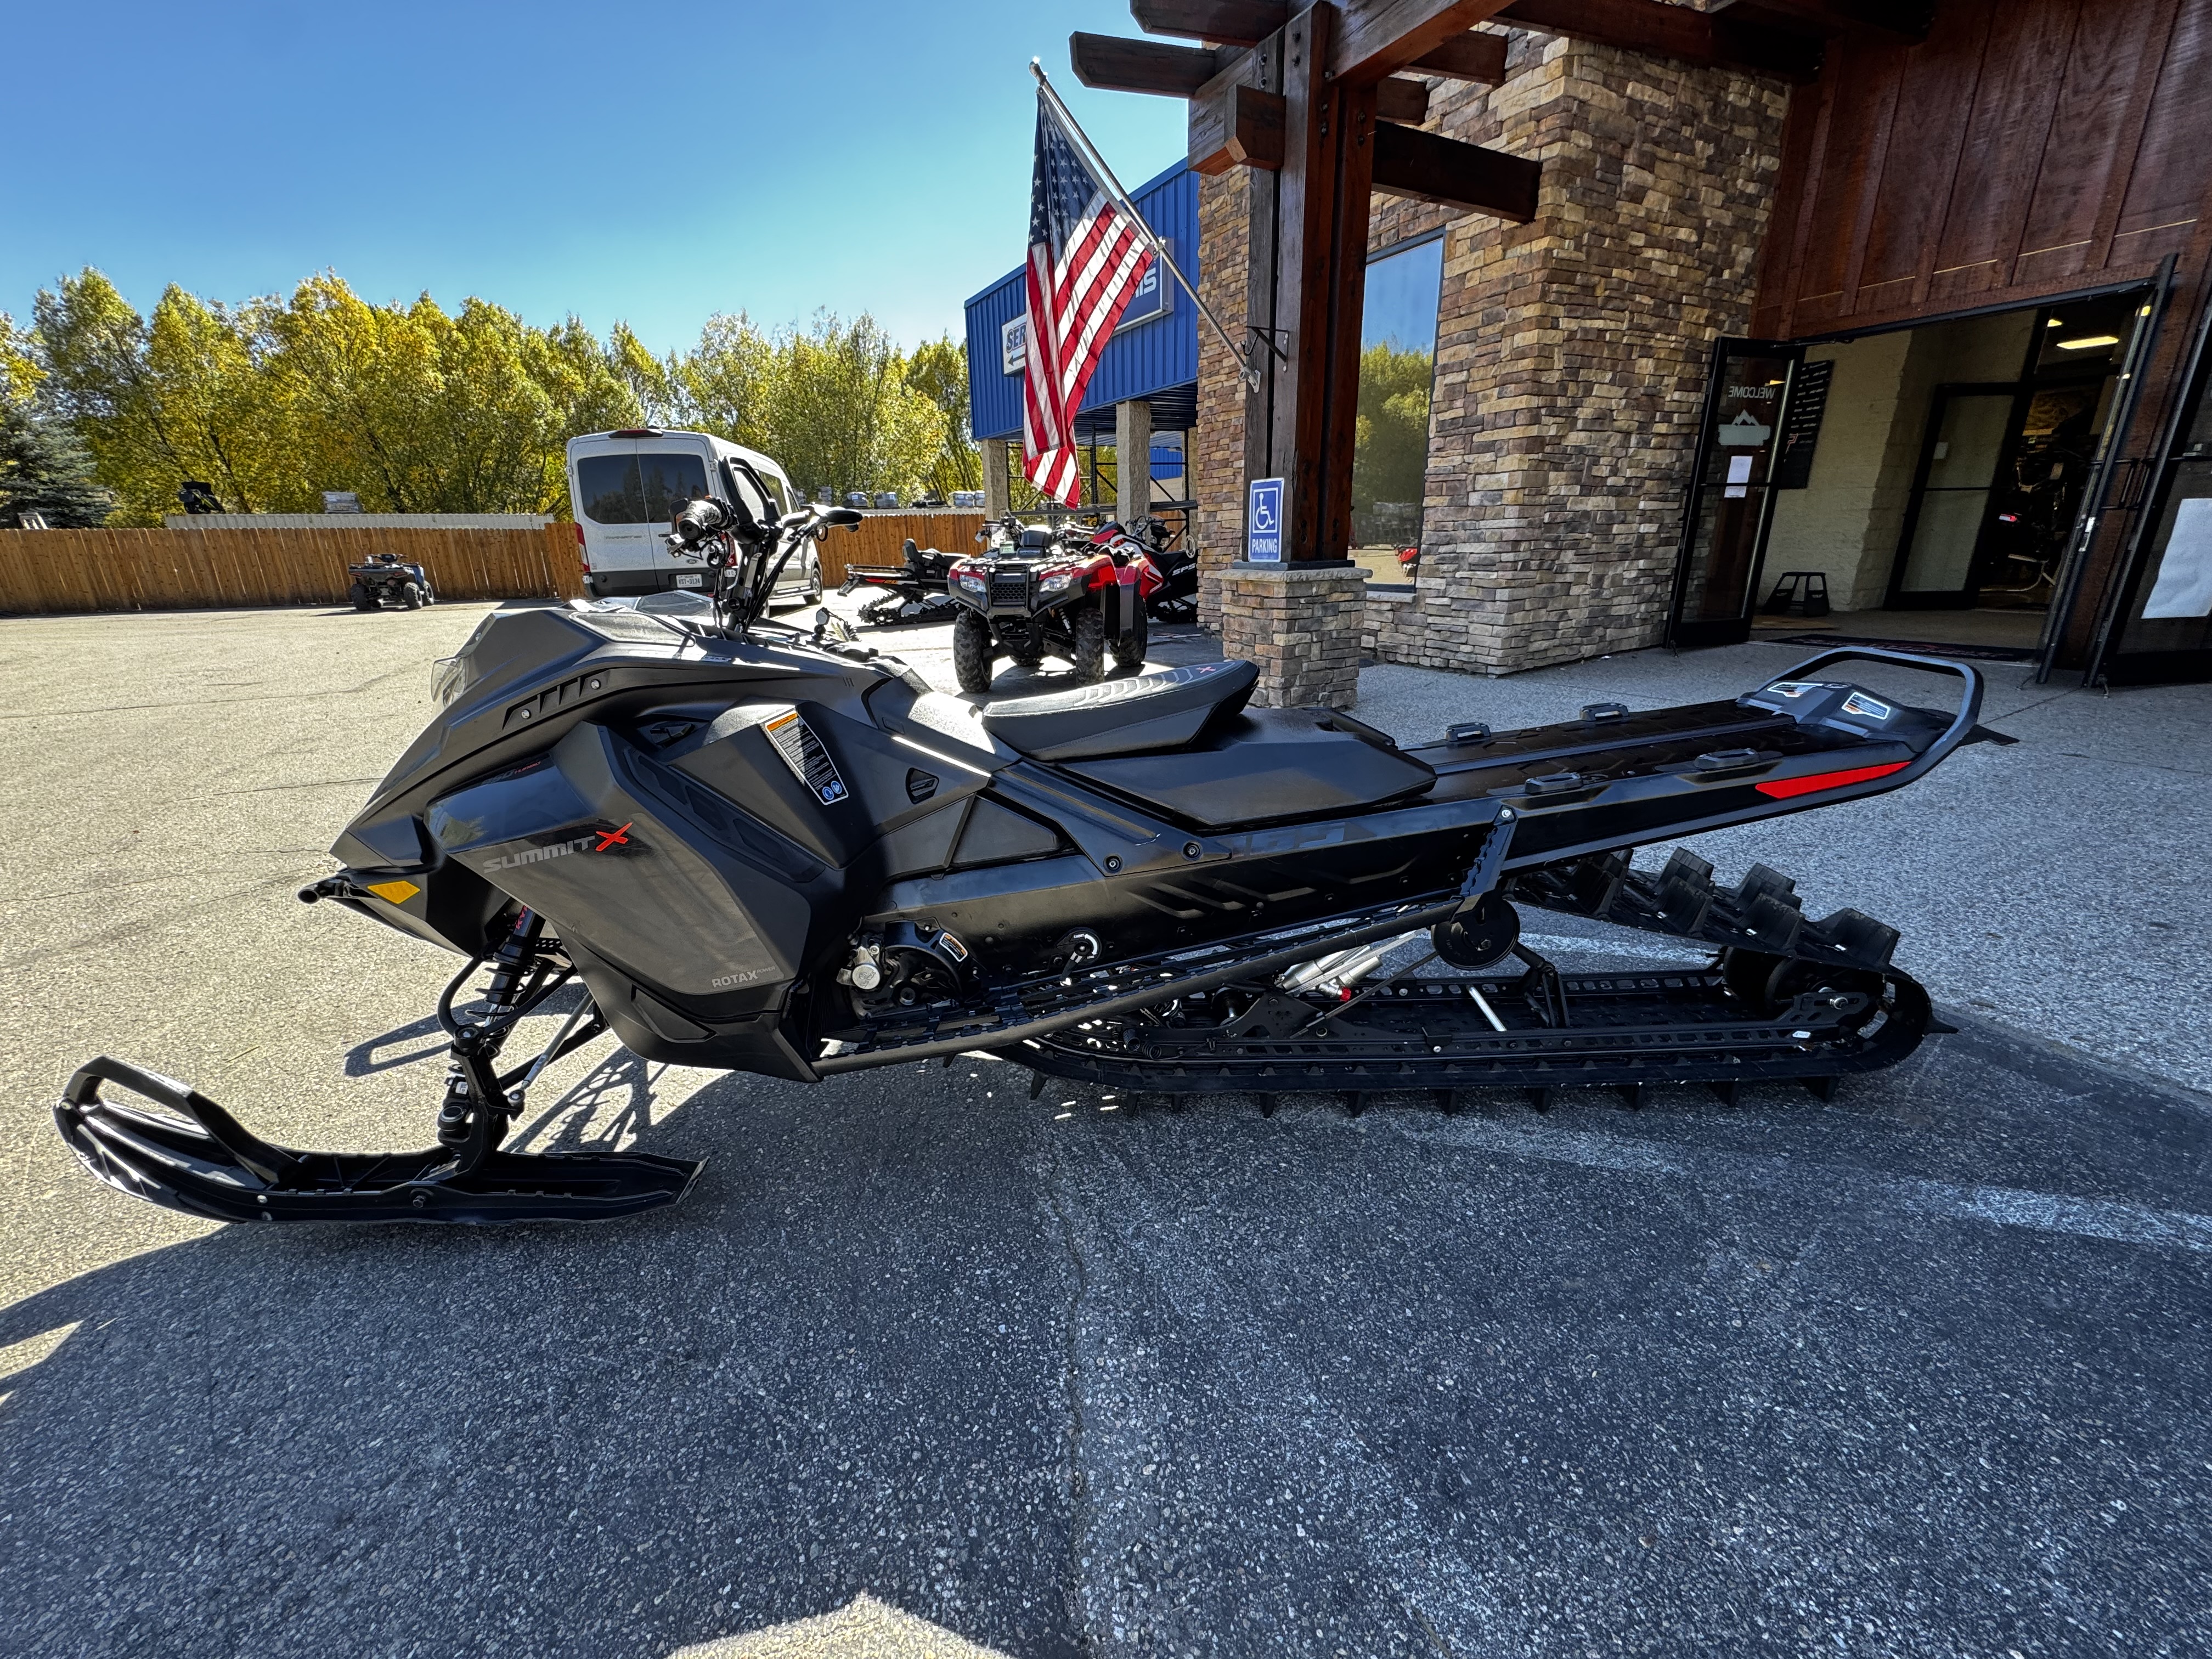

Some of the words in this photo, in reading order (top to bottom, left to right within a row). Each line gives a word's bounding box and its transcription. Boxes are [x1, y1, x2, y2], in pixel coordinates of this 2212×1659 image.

[1136, 267, 1157, 298] IS
[1252, 538, 1278, 554] PARKING
[483, 836, 595, 873] SUMMIT
[596, 822, 633, 851] X
[712, 970, 758, 988] ROTAX
[757, 966, 776, 974] POWER
